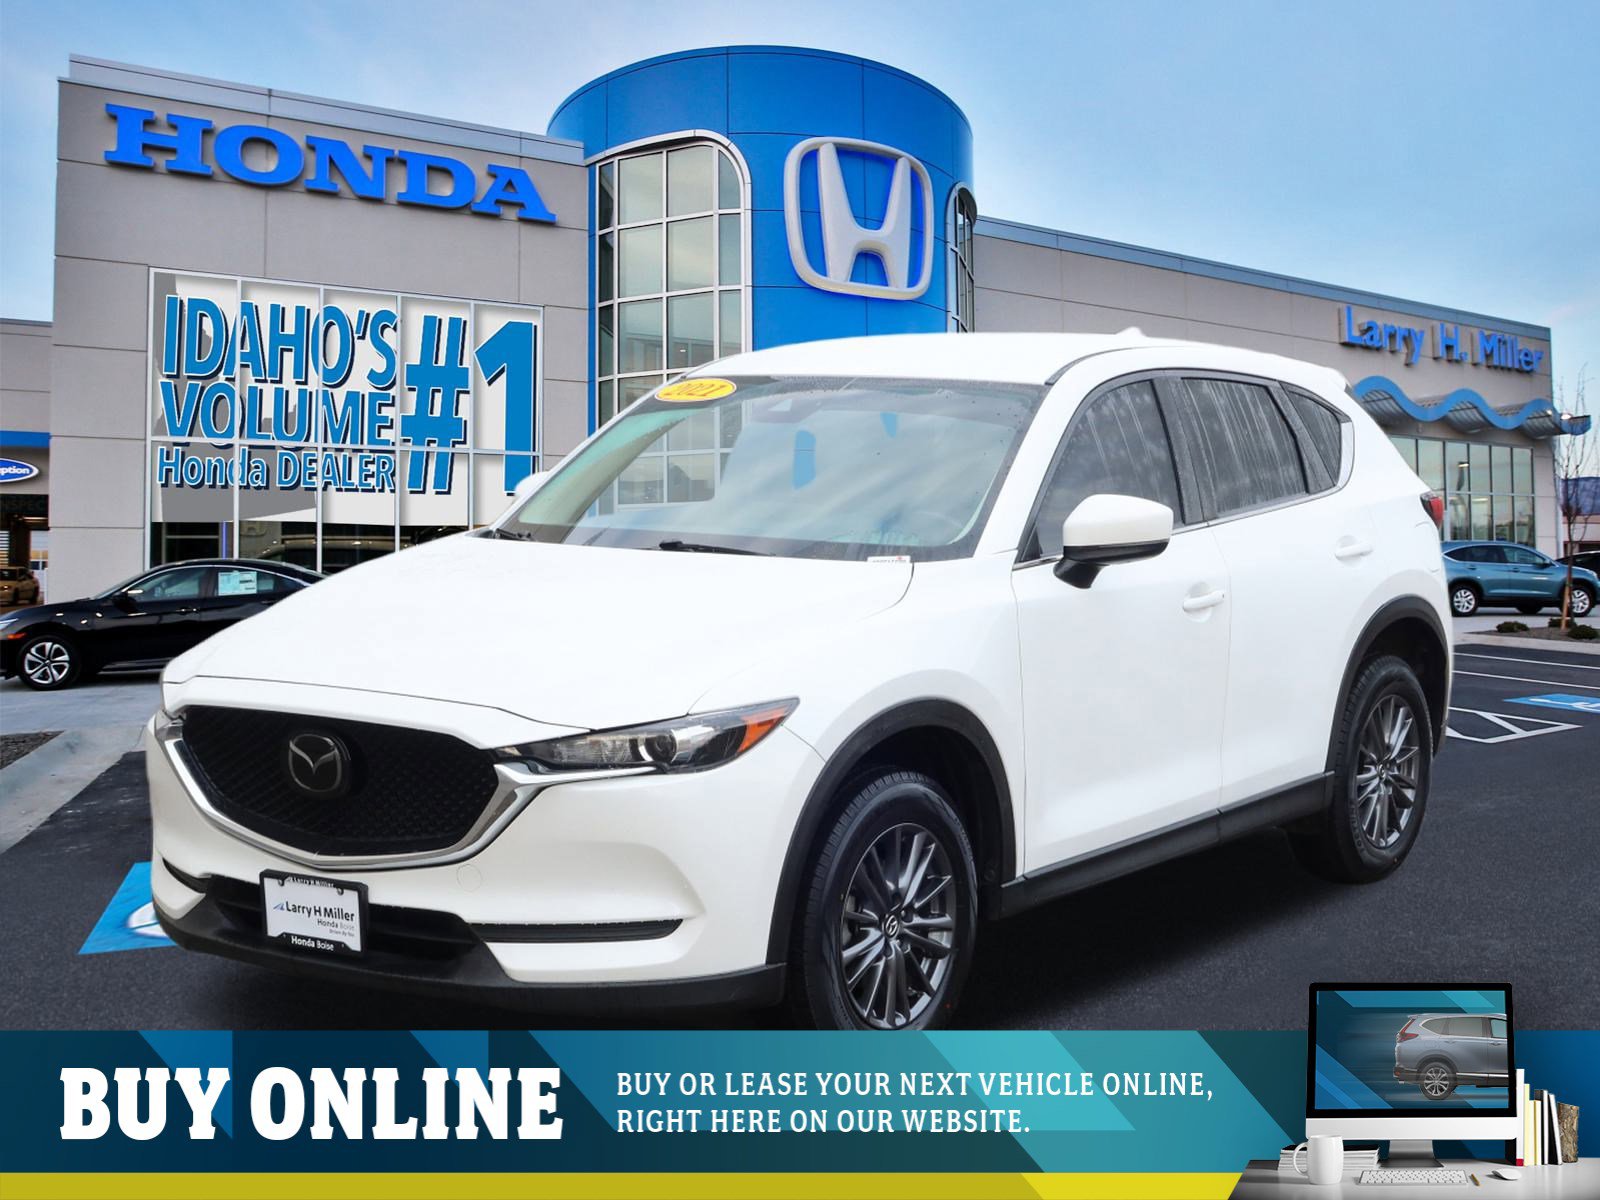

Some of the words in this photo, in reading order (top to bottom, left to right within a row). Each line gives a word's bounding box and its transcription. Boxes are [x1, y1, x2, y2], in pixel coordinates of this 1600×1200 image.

[104, 102, 558, 223] HONDA
[162, 294, 398, 390] IDAHO'S
[1342, 305, 1424, 365] Larry
[1438, 322, 1468, 363] H.
[1476, 330, 1545, 372] Miller
[159, 380, 396, 450] VOLUME
[401, 314, 537, 497] #1
[157, 446, 268, 489] Honda
[276, 450, 396, 493] DEALER
[286, 901, 312, 918] Larry
[314, 905, 322, 917] H
[323, 907, 355, 921] Miller
[291, 935, 315, 948] Honda
[316, 941, 334, 951] Boise
[317, 919, 338, 928] Honda
